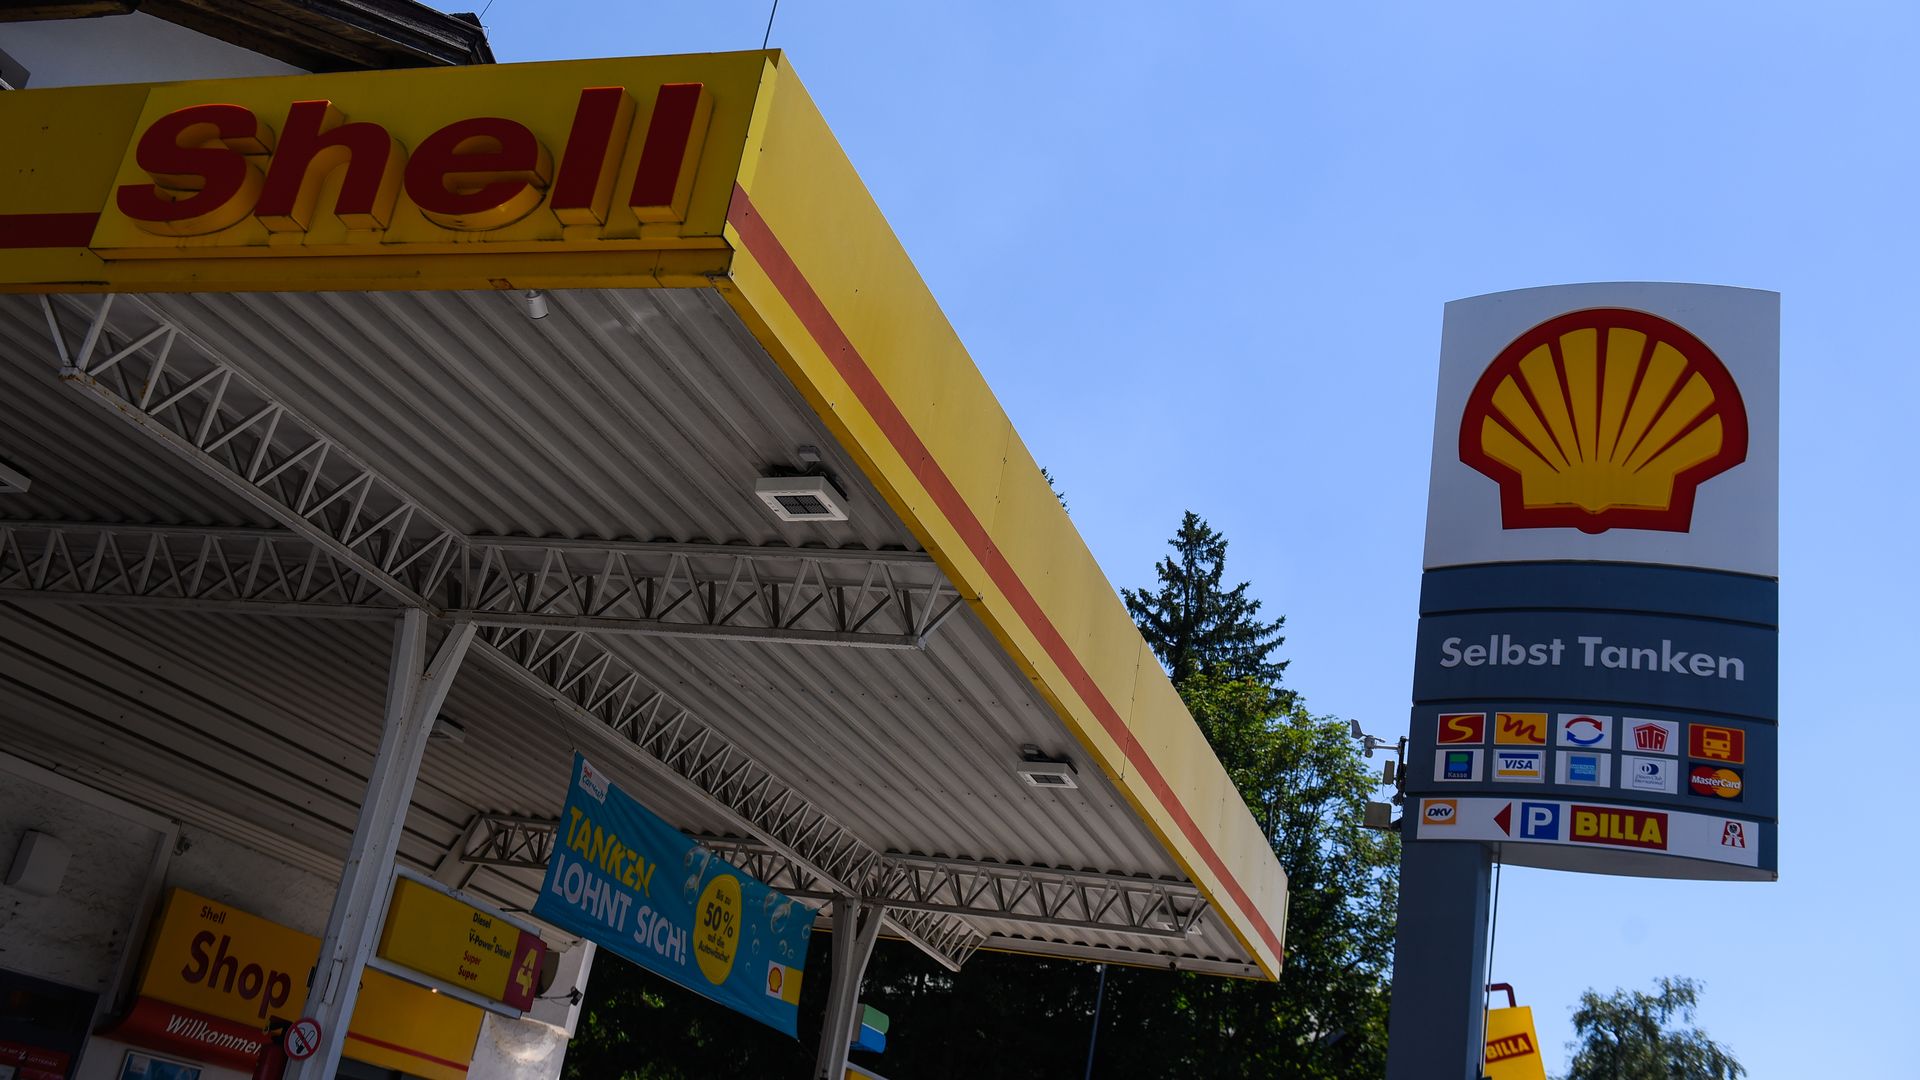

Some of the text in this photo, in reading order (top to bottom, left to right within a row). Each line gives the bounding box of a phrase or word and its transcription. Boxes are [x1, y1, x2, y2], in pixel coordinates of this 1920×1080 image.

[116, 82, 708, 228] Shell
[1439, 633, 1745, 681] Selbst Tanken
[1636, 725, 1666, 750] UTA
[1504, 760, 1533, 769] VISA
[1691, 775, 1742, 789] MasterCard
[1427, 806, 1663, 844] DKV P BILLA
[566, 805, 656, 898] TANKEN
[200, 905, 227, 924] Shell
[473, 912, 492, 928] Diesel
[552, 853, 687, 966] LOHNT SICH!
[463, 950, 482, 966] Super
[469, 932, 512, 959] V-Power Diesel
[181, 931, 291, 1019] Shop
[458, 965, 478, 981] Super
[516, 948, 538, 997] 4
[1486, 1037, 1530, 1059] BILLA
